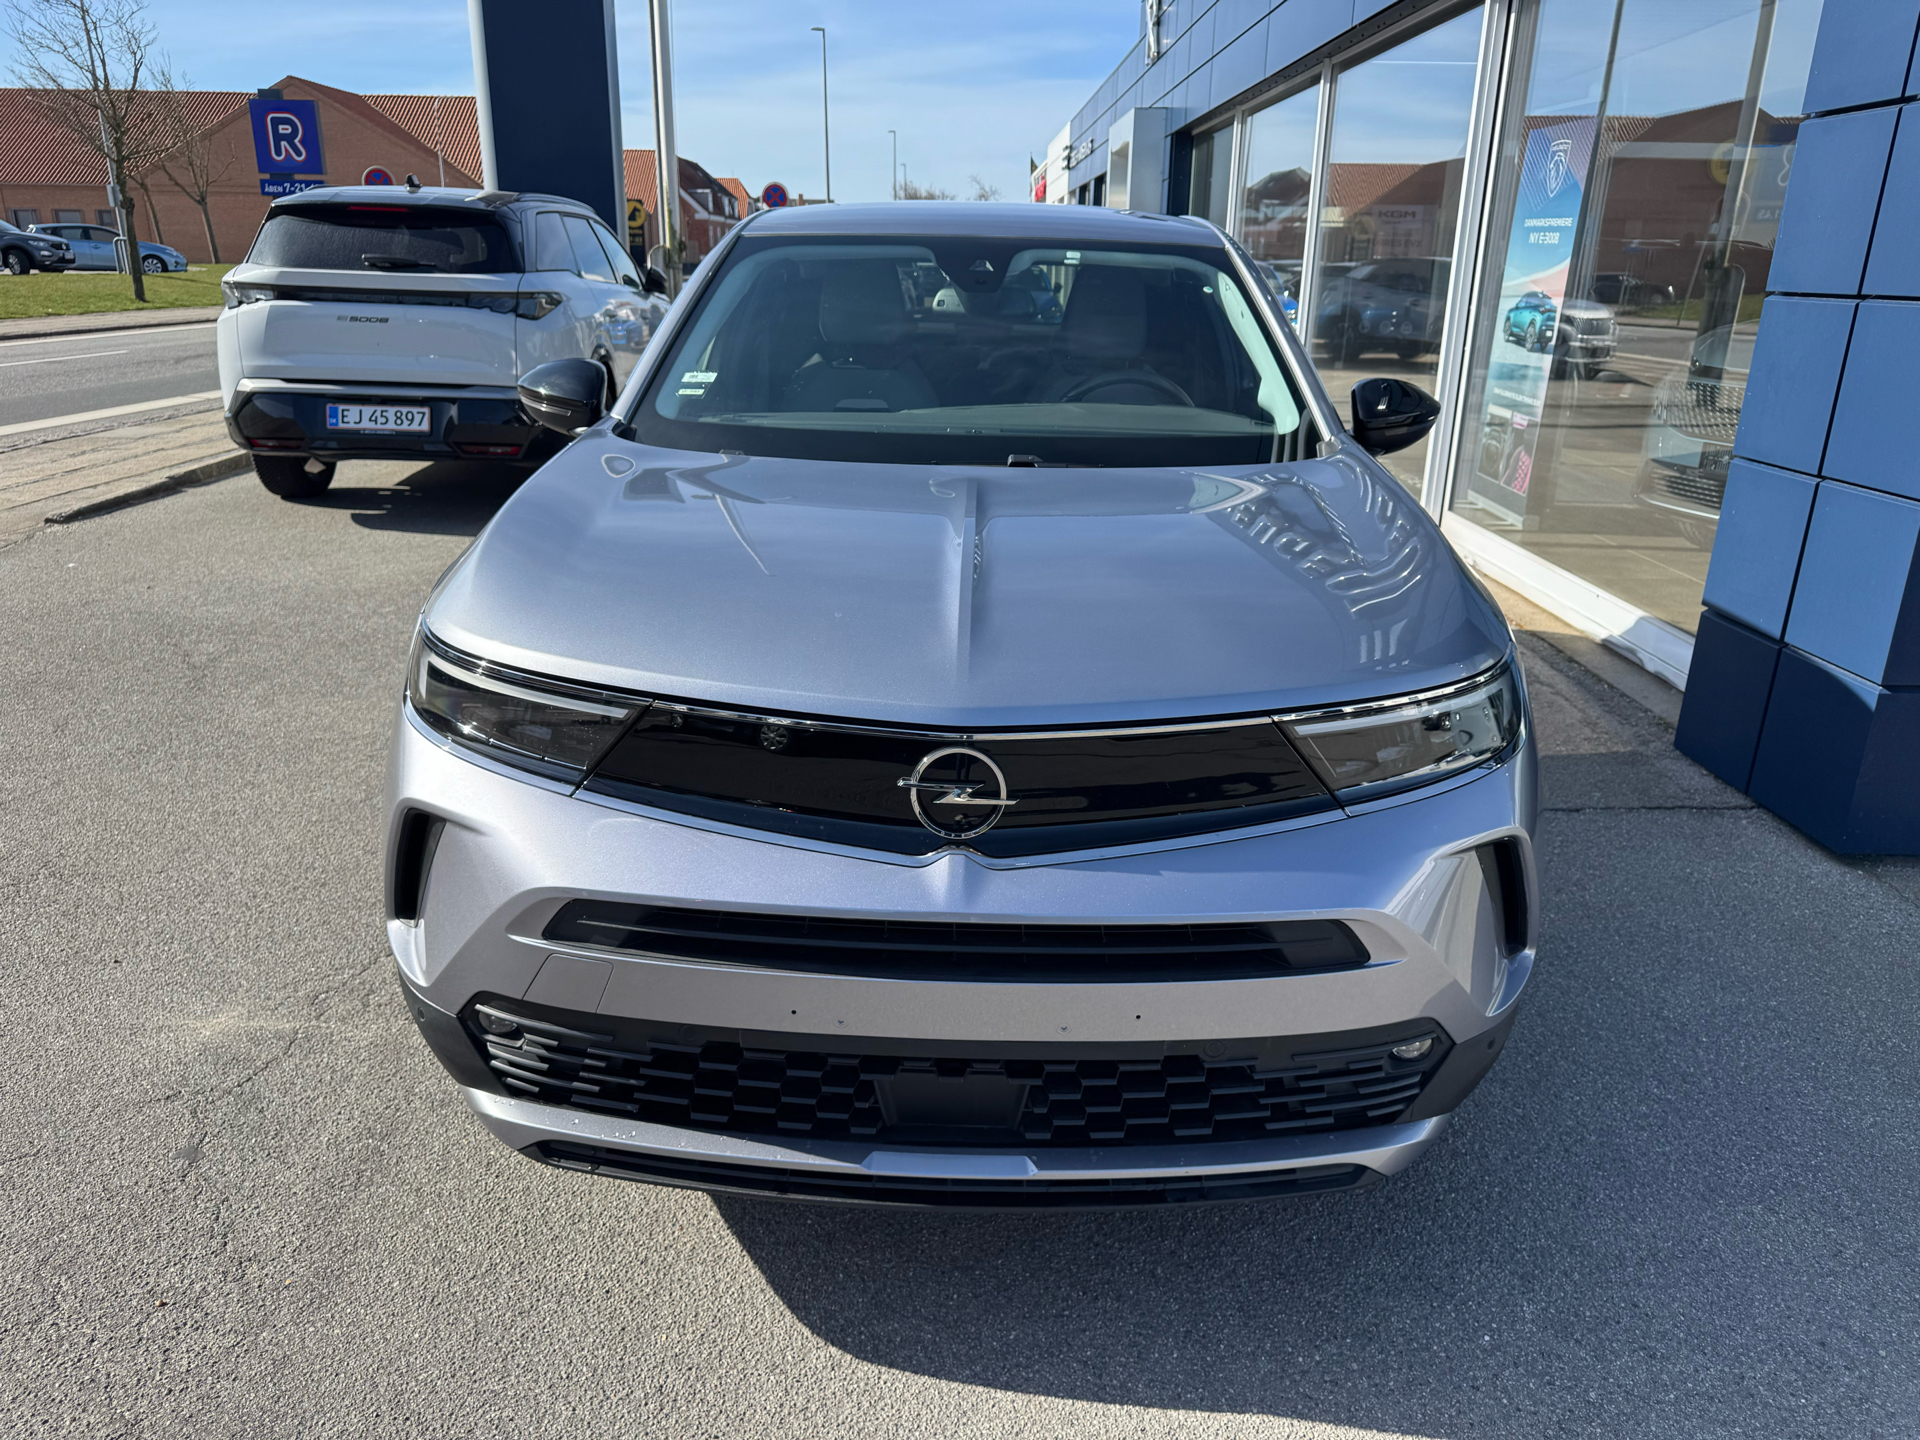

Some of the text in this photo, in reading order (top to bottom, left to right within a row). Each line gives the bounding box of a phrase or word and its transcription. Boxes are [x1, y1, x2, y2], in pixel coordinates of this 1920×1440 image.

[266, 111, 307, 162] R
[1378, 210, 1416, 219] KGM
[341, 408, 426, 427] EJ 45 897
